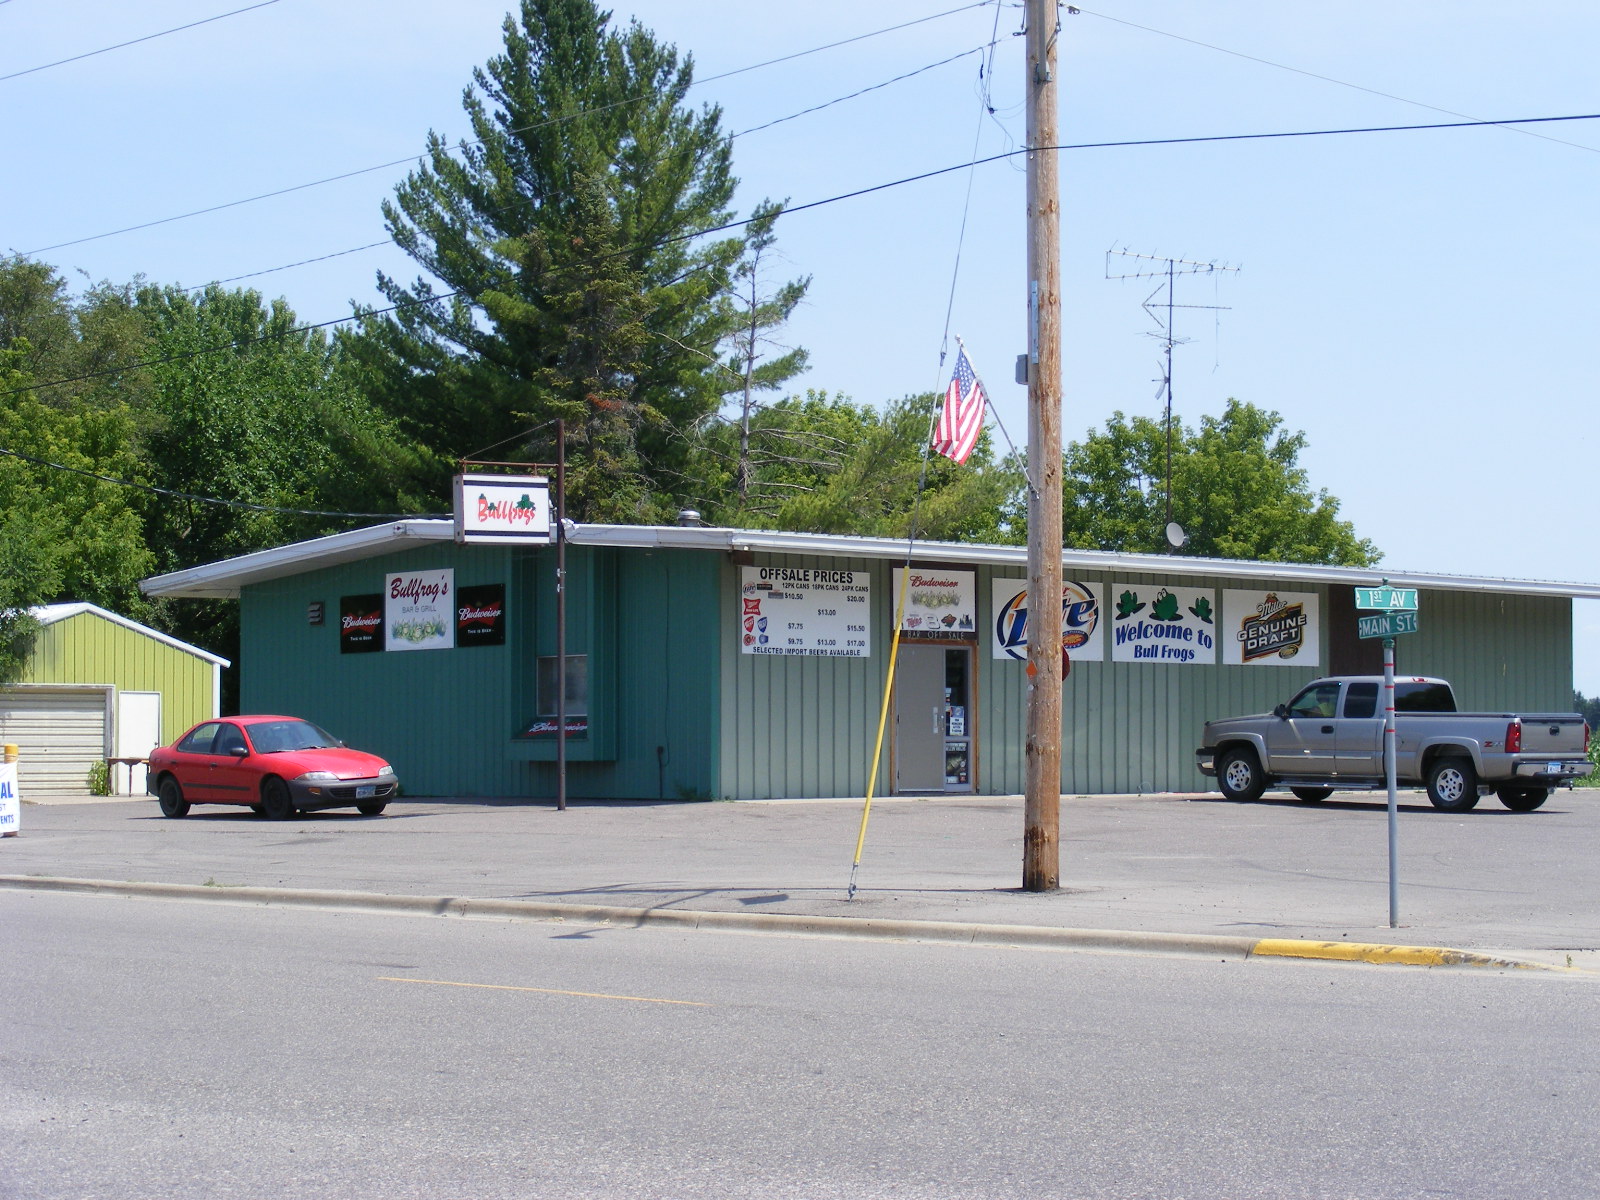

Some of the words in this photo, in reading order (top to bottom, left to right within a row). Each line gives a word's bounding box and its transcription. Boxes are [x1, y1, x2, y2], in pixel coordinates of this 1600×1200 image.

[478, 497, 536, 526] Bullfrogs
[760, 567, 810, 582] OFFSALE
[813, 570, 853, 584] PRICES
[910, 575, 959, 588] Budweiser
[391, 575, 449, 605] Bullfrog's
[782, 582, 795, 590] 12PK
[846, 595, 866, 603] $20.00
[1368, 590, 1383, 607] 1ST
[1389, 591, 1406, 607] AV
[402, 606, 414, 614] BAR
[420, 604, 437, 612] GRILL
[458, 607, 502, 621] Budweiser
[817, 608, 837, 616] $13.00
[1256, 600, 1288, 618] Miller
[342, 615, 382, 628] Budweiser
[787, 622, 804, 630] $7.75
[1236, 614, 1307, 642] GENUINE
[1362, 617, 1390, 637] MAIN
[1396, 614, 1412, 632] ST
[907, 631, 920, 639] BAR
[927, 631, 942, 639] OFF
[948, 631, 964, 640] SALE
[1115, 620, 1193, 646] Welcome
[1197, 629, 1213, 649] to
[1247, 628, 1298, 650] DRAFT
[752, 646, 784, 655] SELECTED
[784, 647, 808, 656] IMPORT
[808, 648, 828, 656] BEERS
[829, 649, 861, 657] AVAILABLE
[1133, 644, 1158, 658] Bull
[1161, 644, 1195, 662] Frogs
